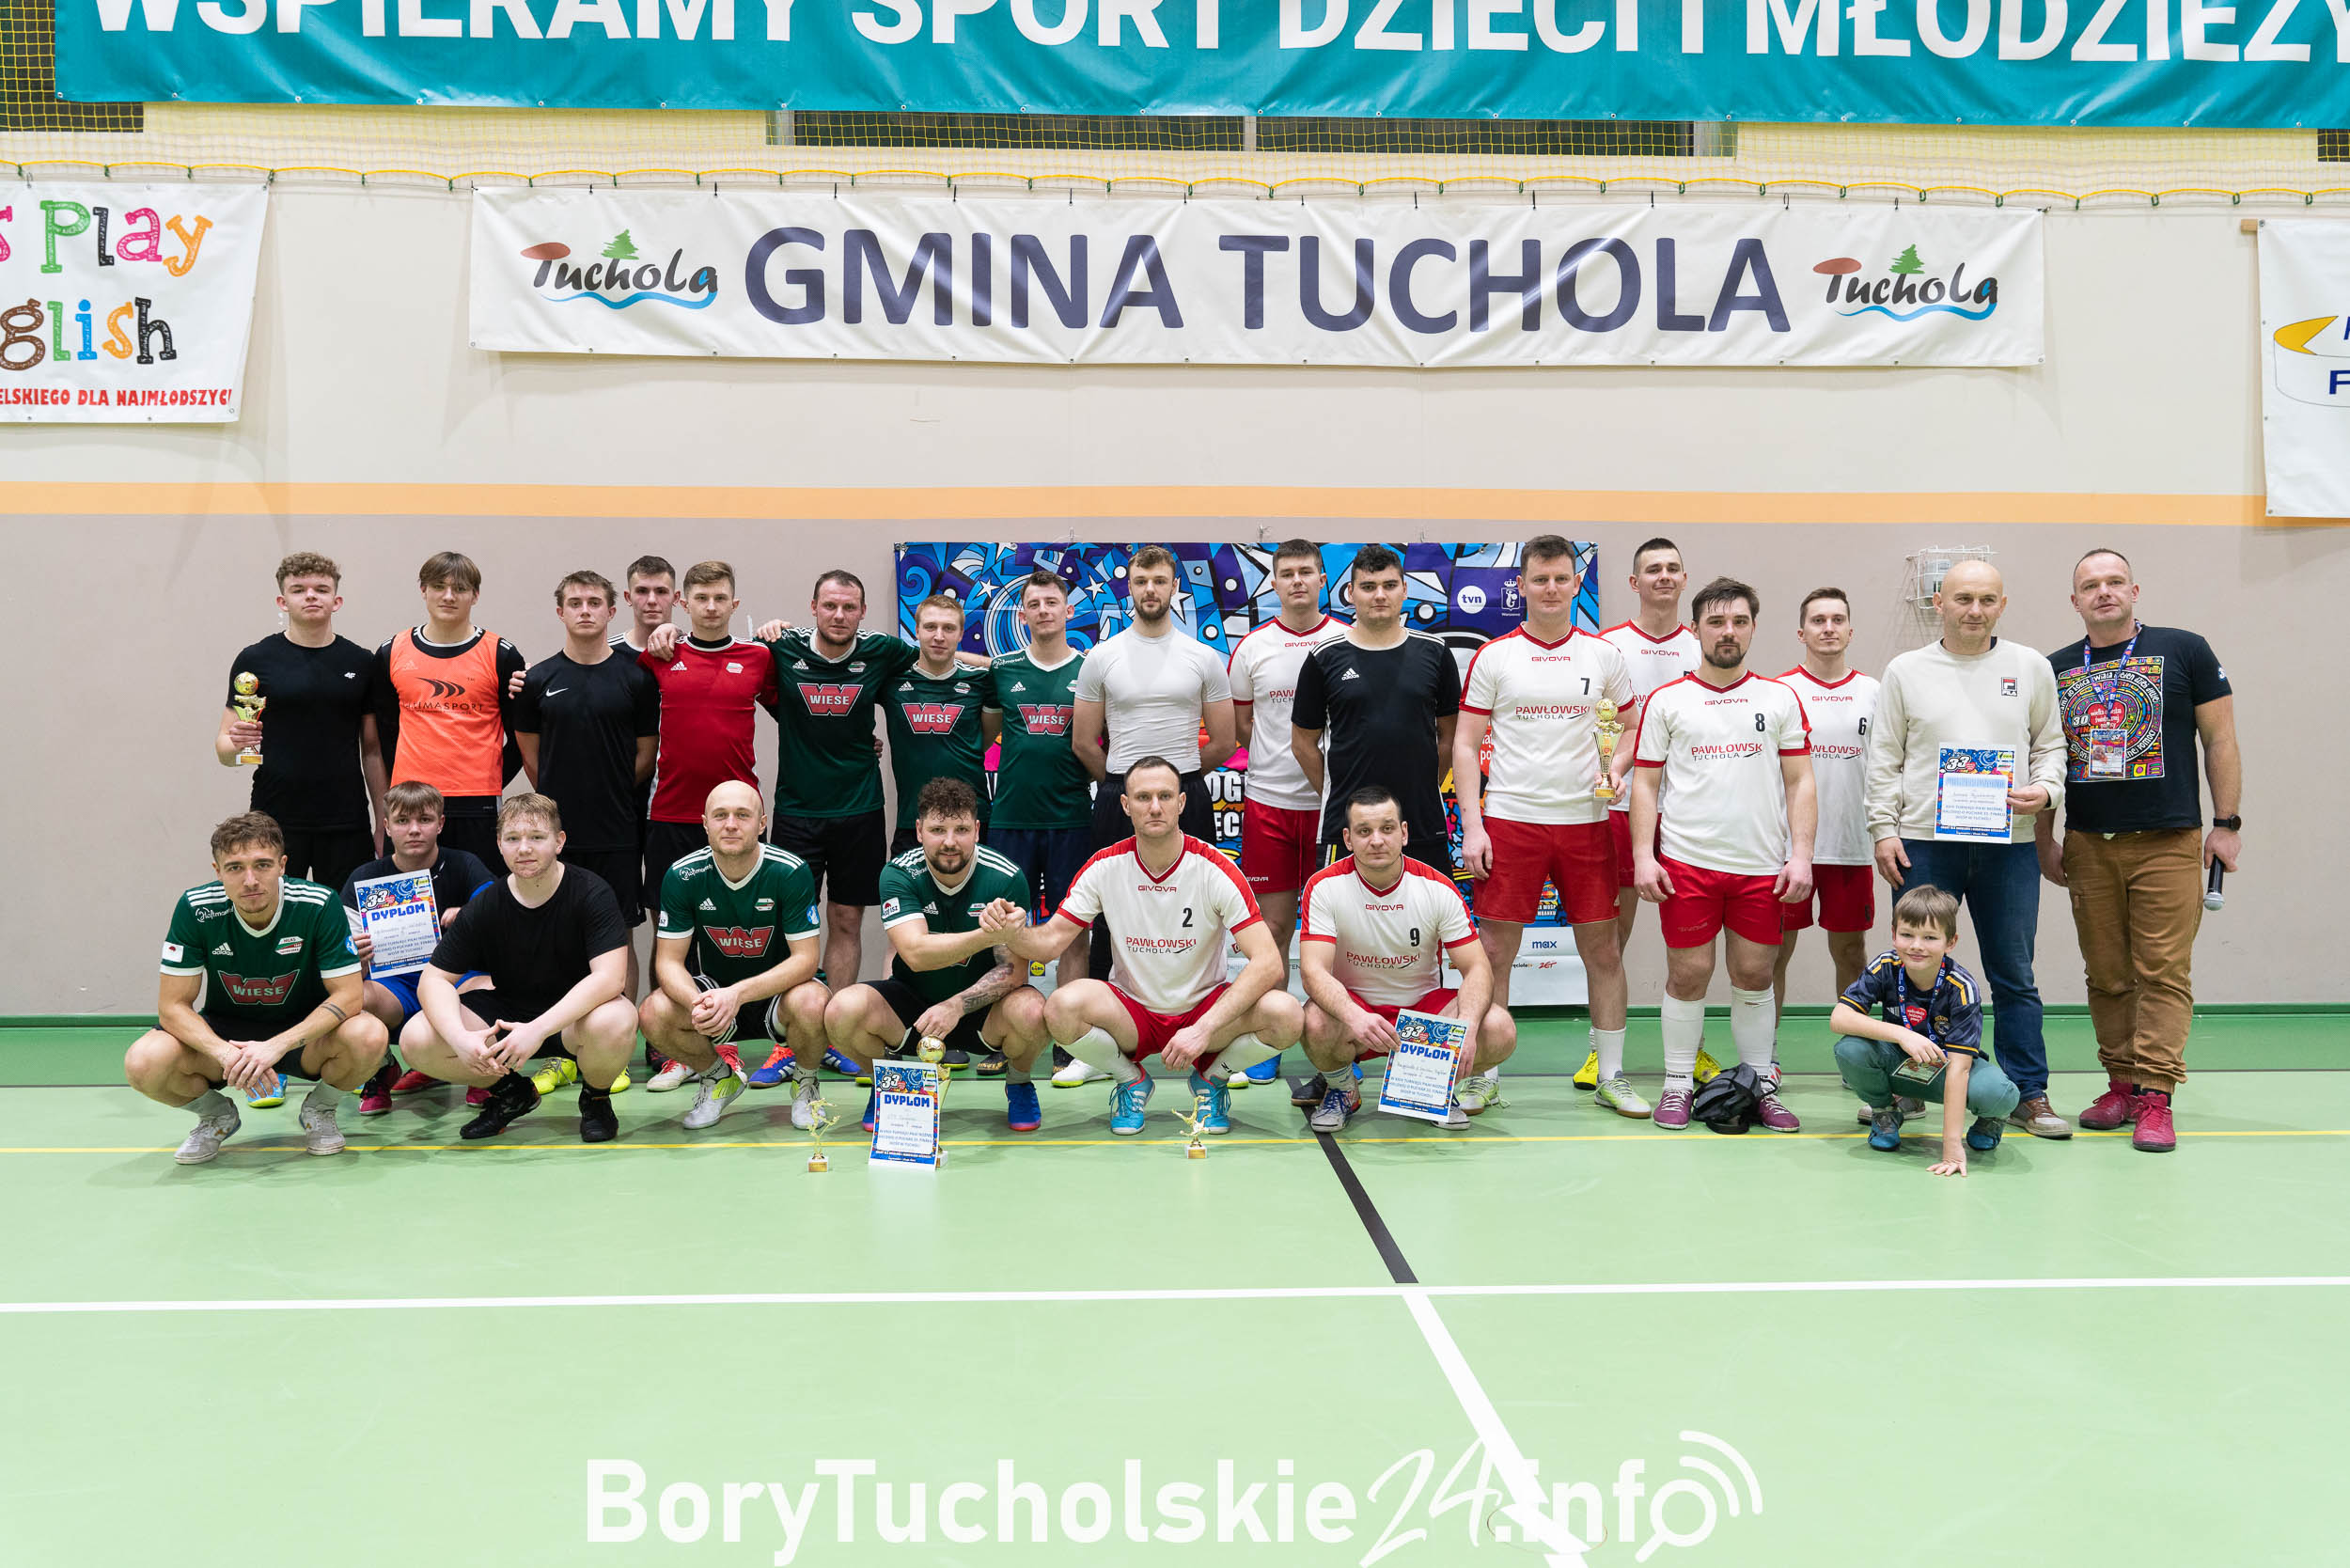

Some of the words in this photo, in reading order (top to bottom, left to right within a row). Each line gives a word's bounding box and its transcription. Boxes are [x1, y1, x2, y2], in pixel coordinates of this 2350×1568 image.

[39, 200, 214, 276] Play
[520, 243, 719, 293] Tuchola
[744, 226, 1184, 329] GMINA
[1218, 233, 1791, 335] TUCHOLA
[1812, 258, 1998, 306] Tuchola
[78, 389, 109, 406] DLA
[1462, 594, 1482, 603] tvn
[1640, 649, 1680, 657] GIVOVA
[1580, 677, 1590, 696] 7
[809, 695, 850, 705] WIESE
[1515, 705, 1590, 715] PAWŁOWSKI
[912, 713, 952, 724] WIESE
[1028, 714, 1065, 725] WIESE
[1755, 713, 1765, 732] 8
[2073, 715, 2089, 726] 30
[1857, 717, 1868, 735] 6
[1691, 743, 1762, 756] PAWŁOWSK
[1694, 752, 1740, 761] TUCHOLA
[1946, 756, 1970, 770] 33
[1137, 885, 1177, 893] GIVOVA
[367, 890, 388, 908] 33
[371, 902, 426, 921] DYPLOM
[1182, 907, 1193, 928] 2
[718, 937, 763, 949] WIESE
[1125, 936, 1197, 949] PAWŁOWSKI
[1409, 928, 1420, 948] 9
[1531, 940, 1558, 949] max
[1127, 946, 1171, 954] TUCHOLA
[1346, 951, 1420, 965] PAWŁOWSKI
[1347, 959, 1395, 969] TUCHOLA
[232, 984, 285, 996] WIESE
[1401, 1025, 1425, 1038] 33
[1400, 1043, 1450, 1061] DYPLOM
[882, 1074, 901, 1089] 33
[884, 1093, 931, 1107] DYPLOM
